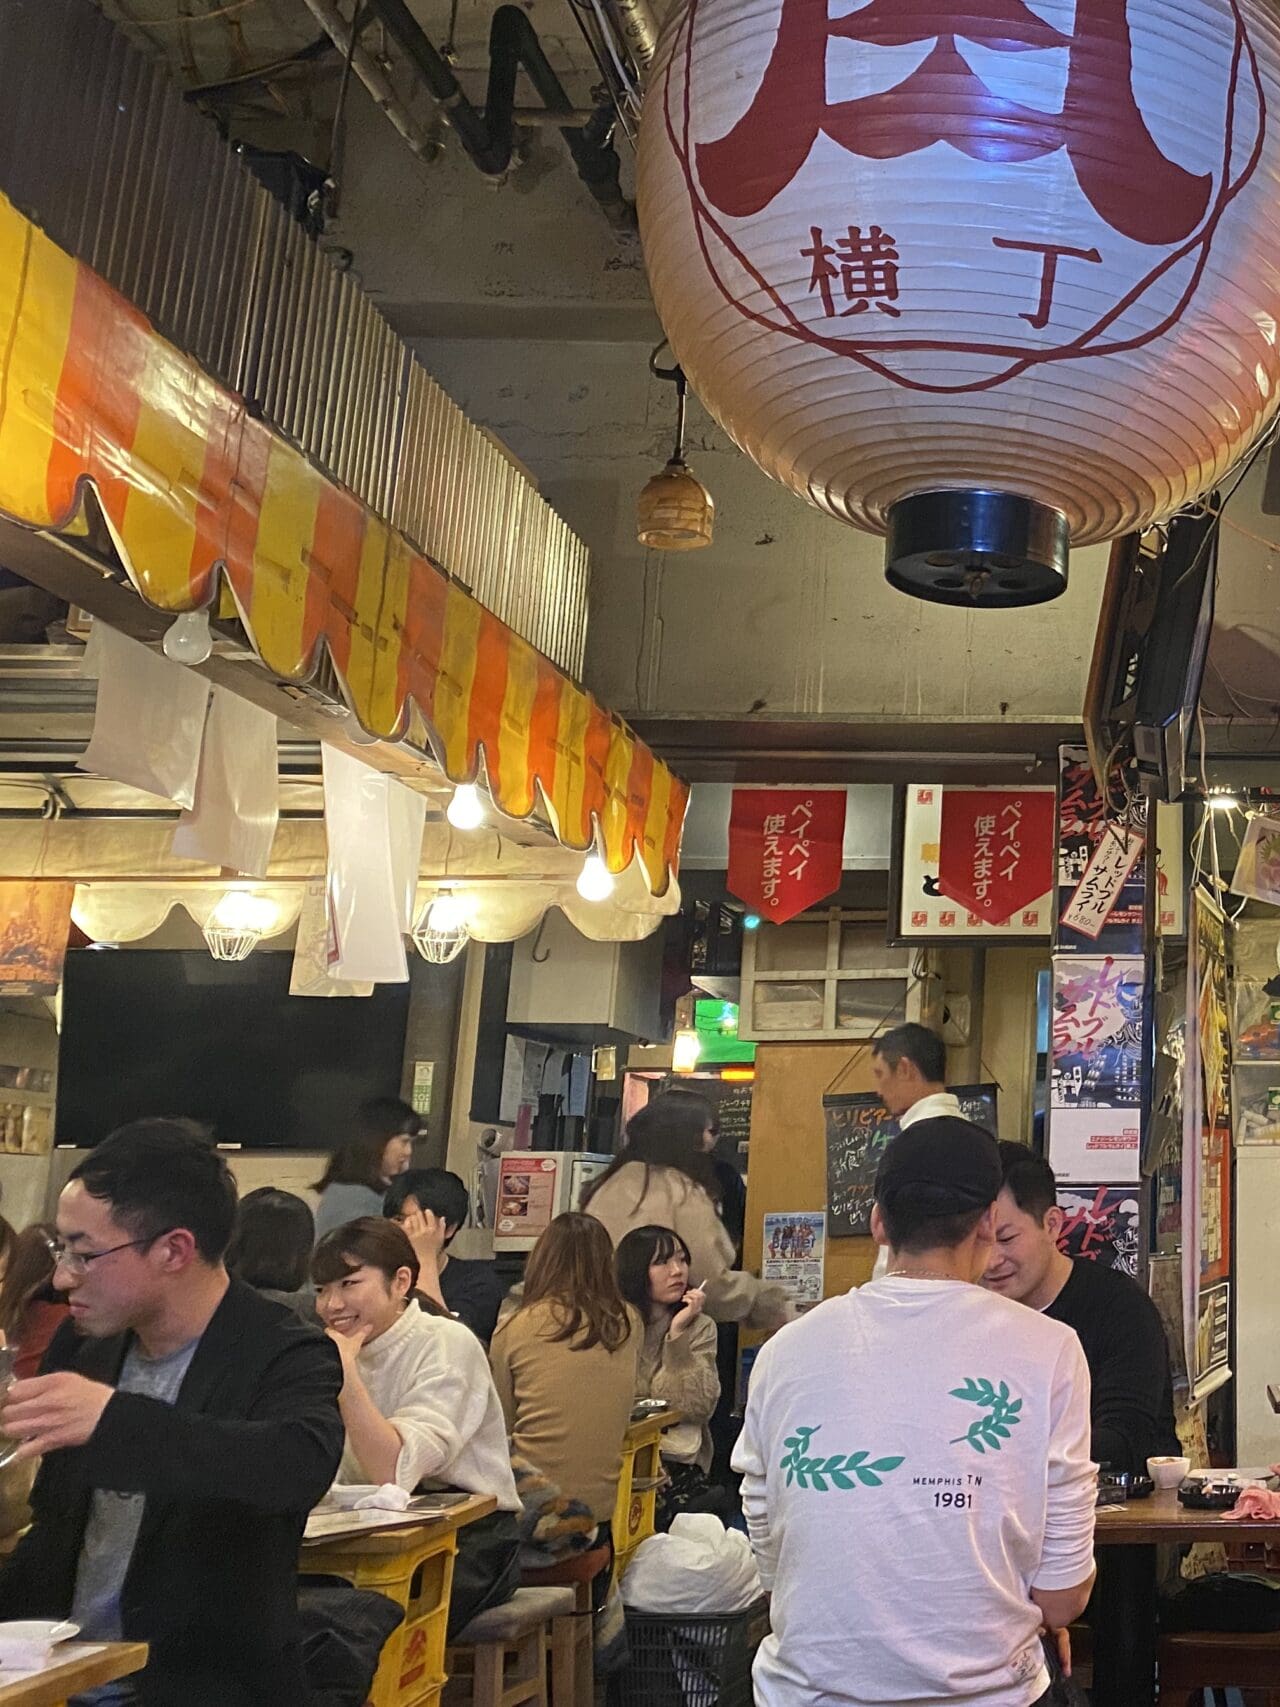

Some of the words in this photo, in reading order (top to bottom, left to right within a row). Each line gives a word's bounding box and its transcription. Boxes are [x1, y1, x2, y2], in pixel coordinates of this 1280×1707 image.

[800, 224, 1103, 331] 横丁
[760, 814, 787, 906] 使えます。
[791, 800, 813, 880] ペイペイ
[972, 815, 997, 907] 使えます。
[1000, 800, 1023, 881] ペイペイ
[1075, 863, 1109, 913] サムライ
[912, 1477, 962, 1487] MEMPHIS
[967, 1474, 983, 1486] TN
[933, 1492, 973, 1509] 1981
